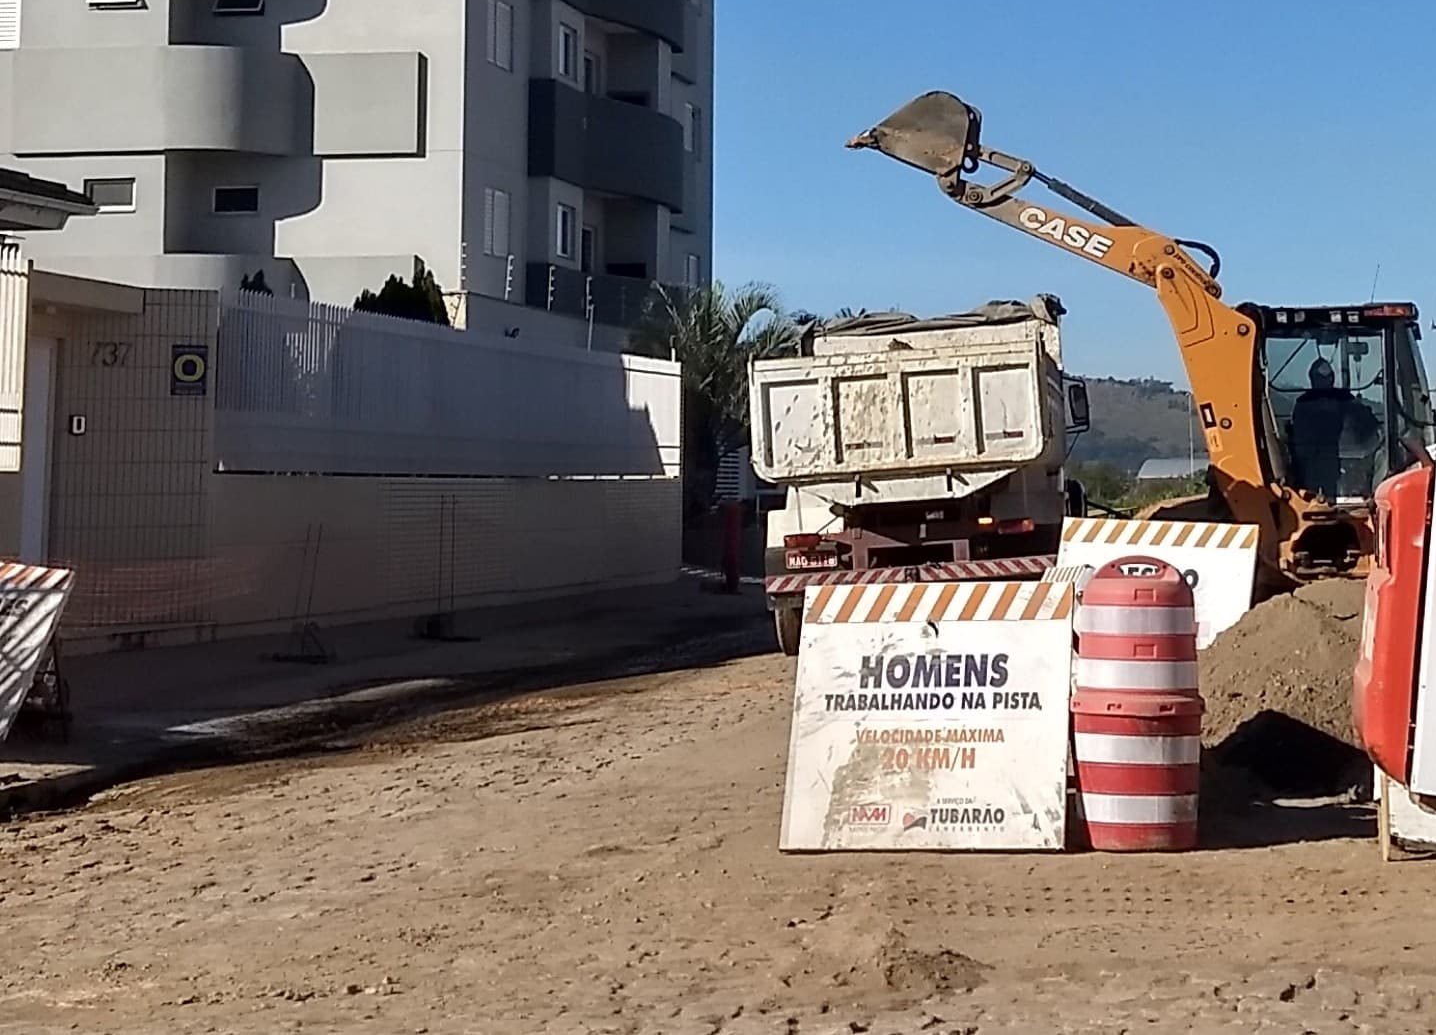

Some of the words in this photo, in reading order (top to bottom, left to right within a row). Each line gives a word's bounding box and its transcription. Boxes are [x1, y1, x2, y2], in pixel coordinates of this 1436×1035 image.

[1019, 207, 1114, 258] CASE
[92, 341, 132, 366] 737
[859, 653, 1009, 689] HOMENS
[825, 693, 954, 711] TRABALHANDO
[961, 692, 986, 710] NA
[856, 729, 941, 744] VELOCIDADE
[944, 725, 1005, 743] MÁXIMA
[881, 748, 909, 770] 20
[915, 747, 976, 771] KM/H
[930, 803, 1004, 824] TUBARÃO
